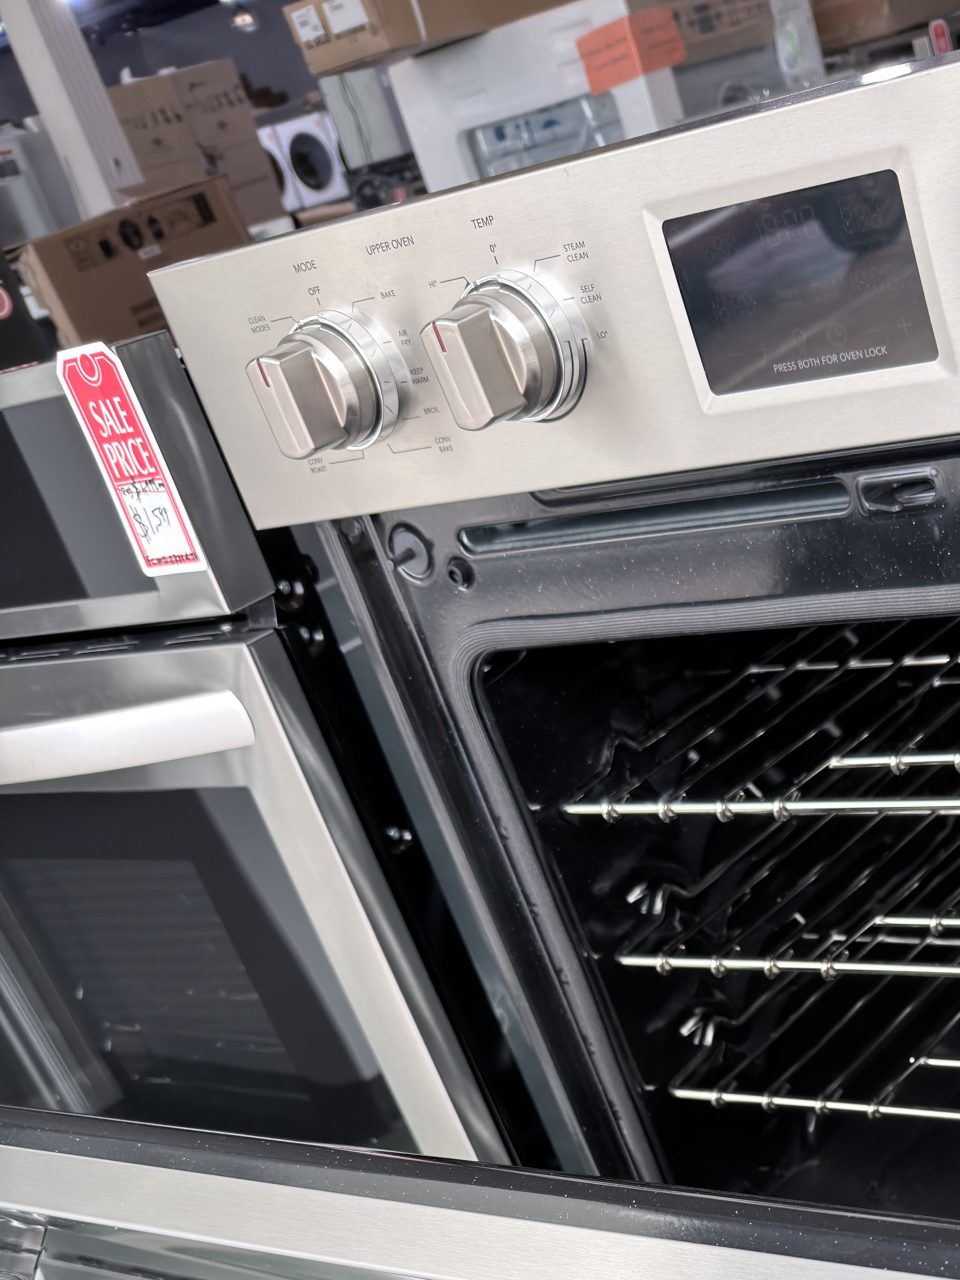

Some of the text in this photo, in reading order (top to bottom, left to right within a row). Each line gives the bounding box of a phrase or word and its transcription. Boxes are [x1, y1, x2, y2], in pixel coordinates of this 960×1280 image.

[470, 215, 495, 229] TEMP
[366, 235, 415, 256] UPPER OVEN
[563, 240, 586, 252] STEAM
[566, 251, 589, 263] CLEAN
[293, 260, 318, 274] MODE
[307, 286, 321, 296] OFF
[380, 289, 397, 300] BAKE
[580, 283, 595, 293] SELF
[580, 293, 602, 305] CLEAN
[772, 345, 889, 374] PRESS BOTH FOR OVEN LOCK
[88, 396, 135, 438] SALE
[102, 437, 156, 479] PRICE
